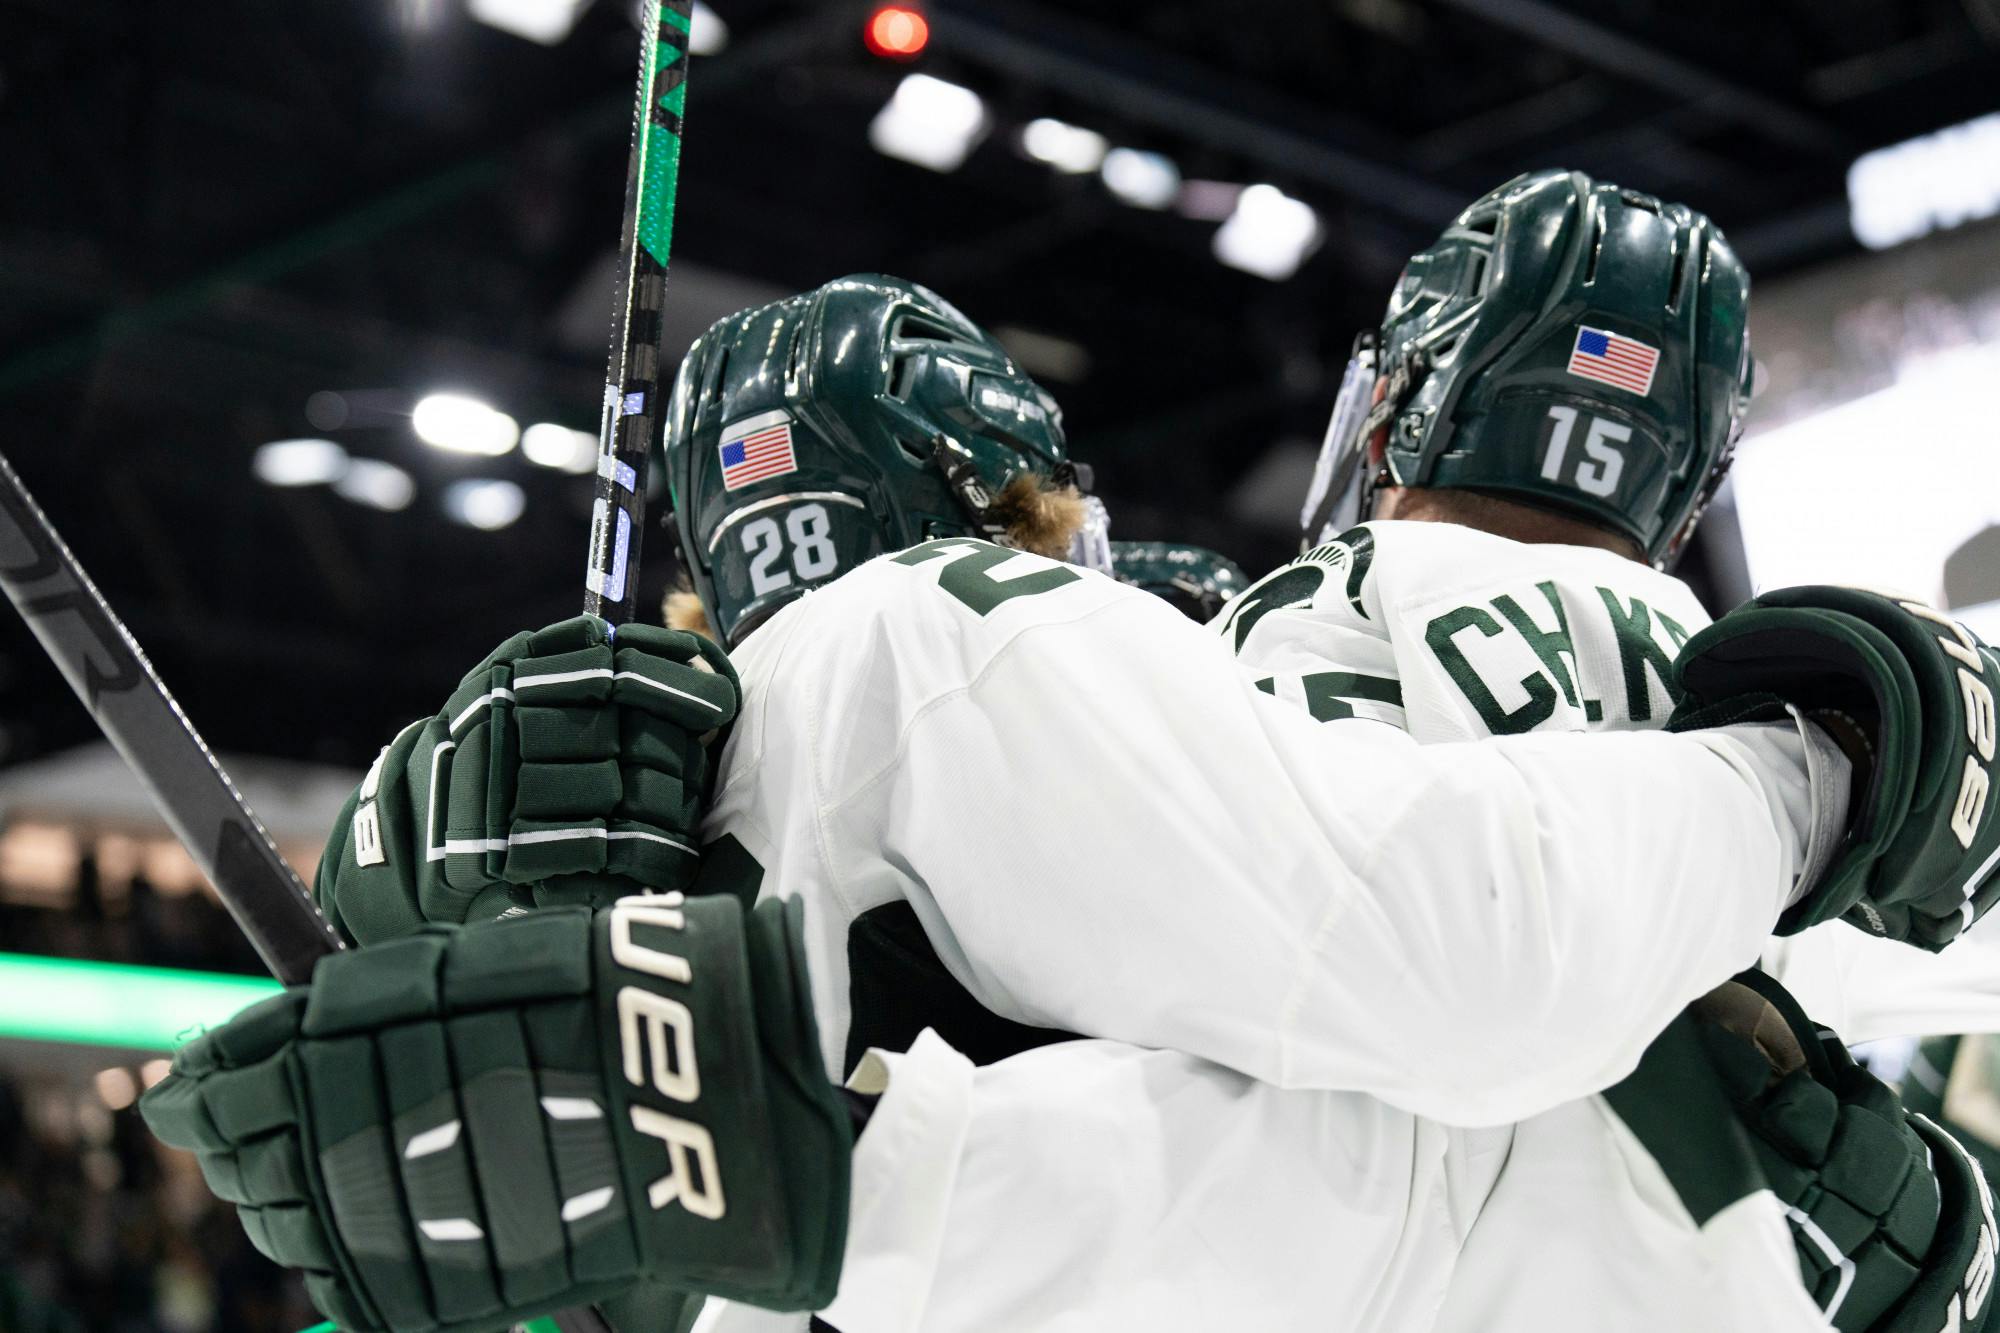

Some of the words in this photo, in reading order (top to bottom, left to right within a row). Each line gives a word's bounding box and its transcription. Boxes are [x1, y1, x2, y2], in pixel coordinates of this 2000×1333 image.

[1540, 406, 1632, 497] 15
[741, 504, 838, 597] 28
[611, 889, 726, 1220] UER
